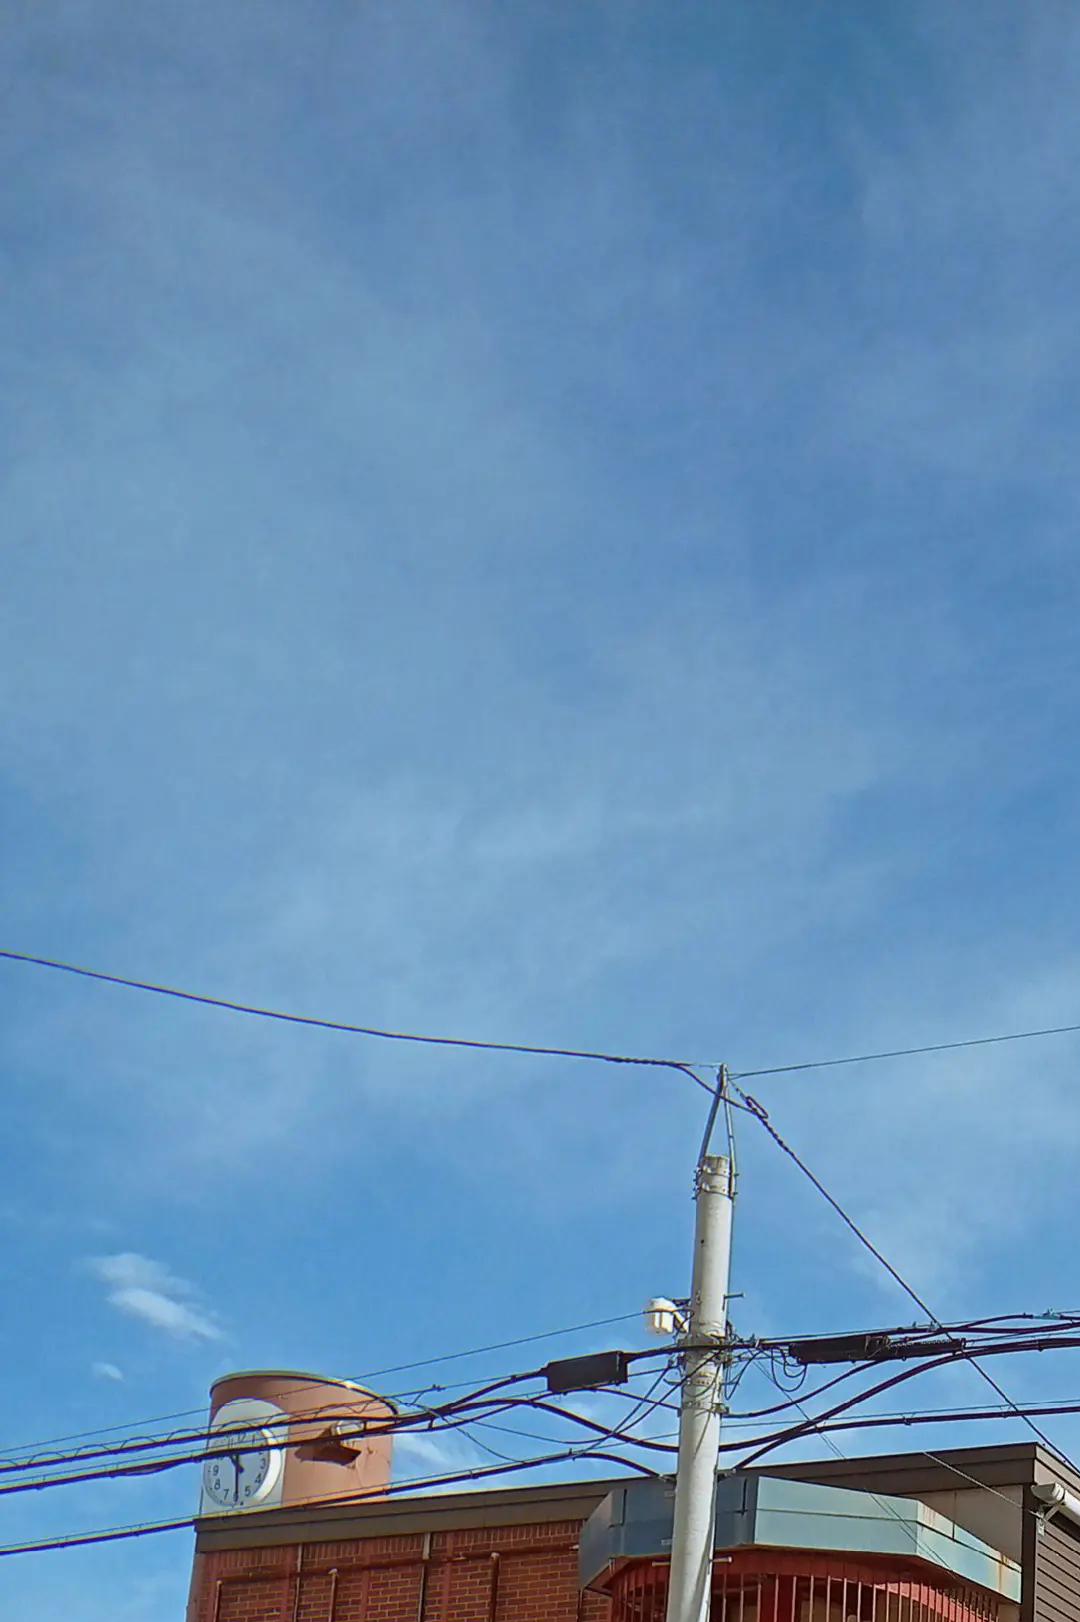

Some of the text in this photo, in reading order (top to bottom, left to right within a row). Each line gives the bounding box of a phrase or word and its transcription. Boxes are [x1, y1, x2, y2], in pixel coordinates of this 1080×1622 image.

[213, 1465, 219, 1476] 9
[223, 1489, 229, 1500] 7
[245, 1486, 251, 1497] 5
